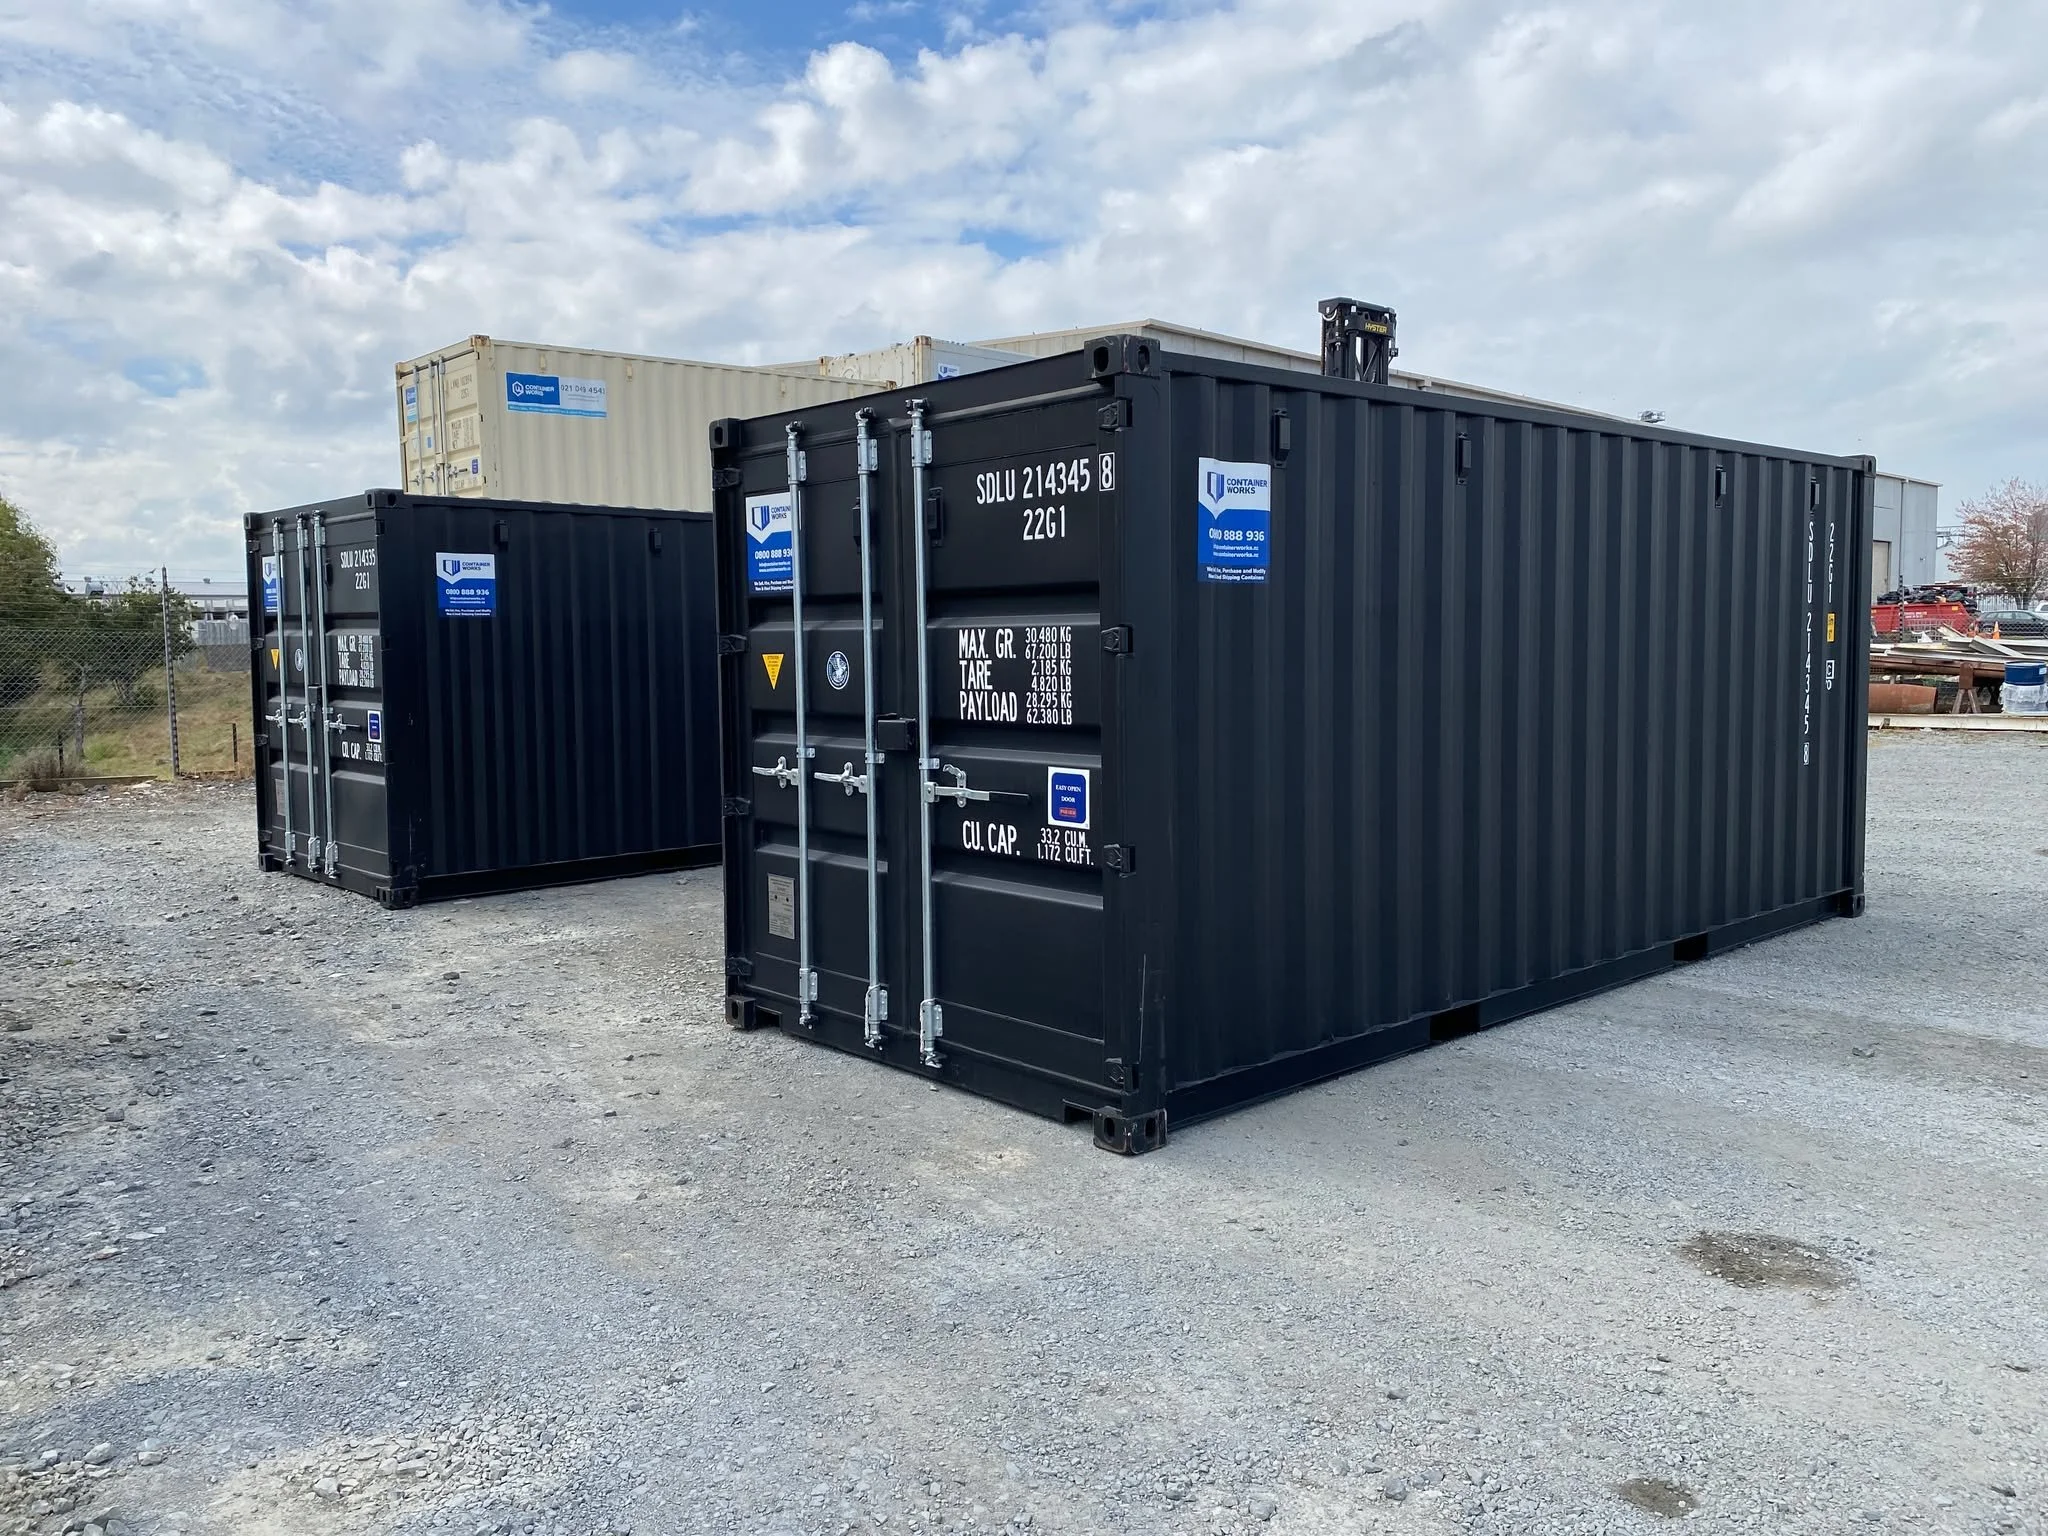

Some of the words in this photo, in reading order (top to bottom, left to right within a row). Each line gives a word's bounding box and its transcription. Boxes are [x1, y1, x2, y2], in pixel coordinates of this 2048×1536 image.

[1365, 322, 1387, 334] HYSTER
[560, 384, 573, 392] 021
[976, 469, 1016, 505] SDLU
[1022, 458, 1091, 499] 214345
[1101, 455, 1113, 489] 8
[1226, 478, 1267, 488] CONTAINER
[1227, 486, 1256, 494] WORKS
[1023, 505, 1066, 541] 22G1
[1223, 530, 1243, 541] 888
[1245, 530, 1265, 541] 936
[354, 548, 376, 567] 214335
[755, 550, 770, 559] 0800
[771, 549, 782, 558] 888
[1807, 521, 1815, 604] SDLU
[355, 571, 370, 590] 22G1
[1060, 626, 1072, 643] KG
[958, 628, 989, 659] MAX.
[995, 628, 1017, 659] GR.
[1060, 643, 1071, 659] LB
[959, 660, 993, 690] TARE
[1060, 659, 1072, 676] KG
[1804, 612, 1812, 735] 214345
[1060, 675, 1072, 692] LB
[959, 691, 1018, 722] PAYLOAD
[1060, 692, 1072, 709] KG
[1061, 708, 1073, 725] LB
[1067, 785, 1082, 793] OPEN
[1060, 795, 1076, 803] DOOR
[962, 820, 985, 851] CU.
[987, 823, 1021, 856] CAP.
[1040, 827, 1060, 845] 33.2
